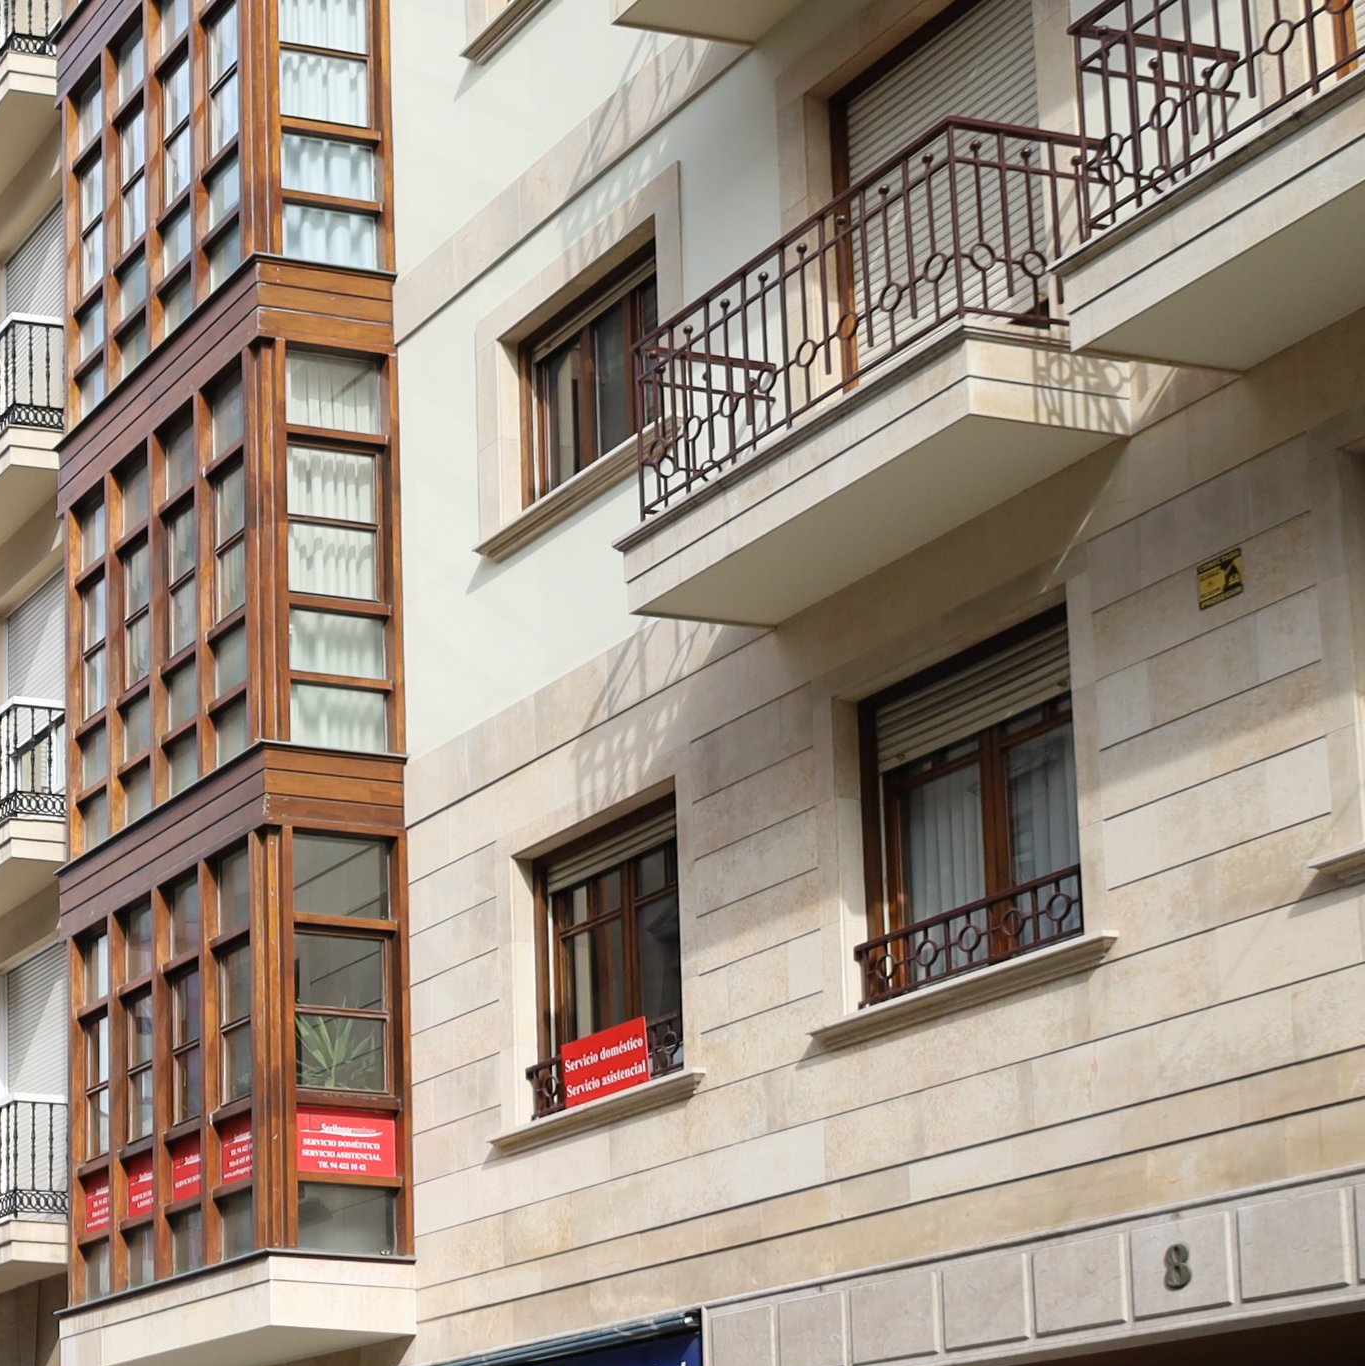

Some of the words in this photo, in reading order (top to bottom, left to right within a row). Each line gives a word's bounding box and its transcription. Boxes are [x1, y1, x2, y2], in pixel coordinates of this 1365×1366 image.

[564, 1052, 598, 1073] Servicio
[600, 1036, 643, 1061] doméstico
[566, 1076, 600, 1098] Servicio
[601, 1059, 646, 1086] asistencial
[302, 1138, 337, 1146] SERVICIO
[301, 1149, 335, 1158] SERVICIO
[336, 1152, 382, 1161] ASISTENCIAL
